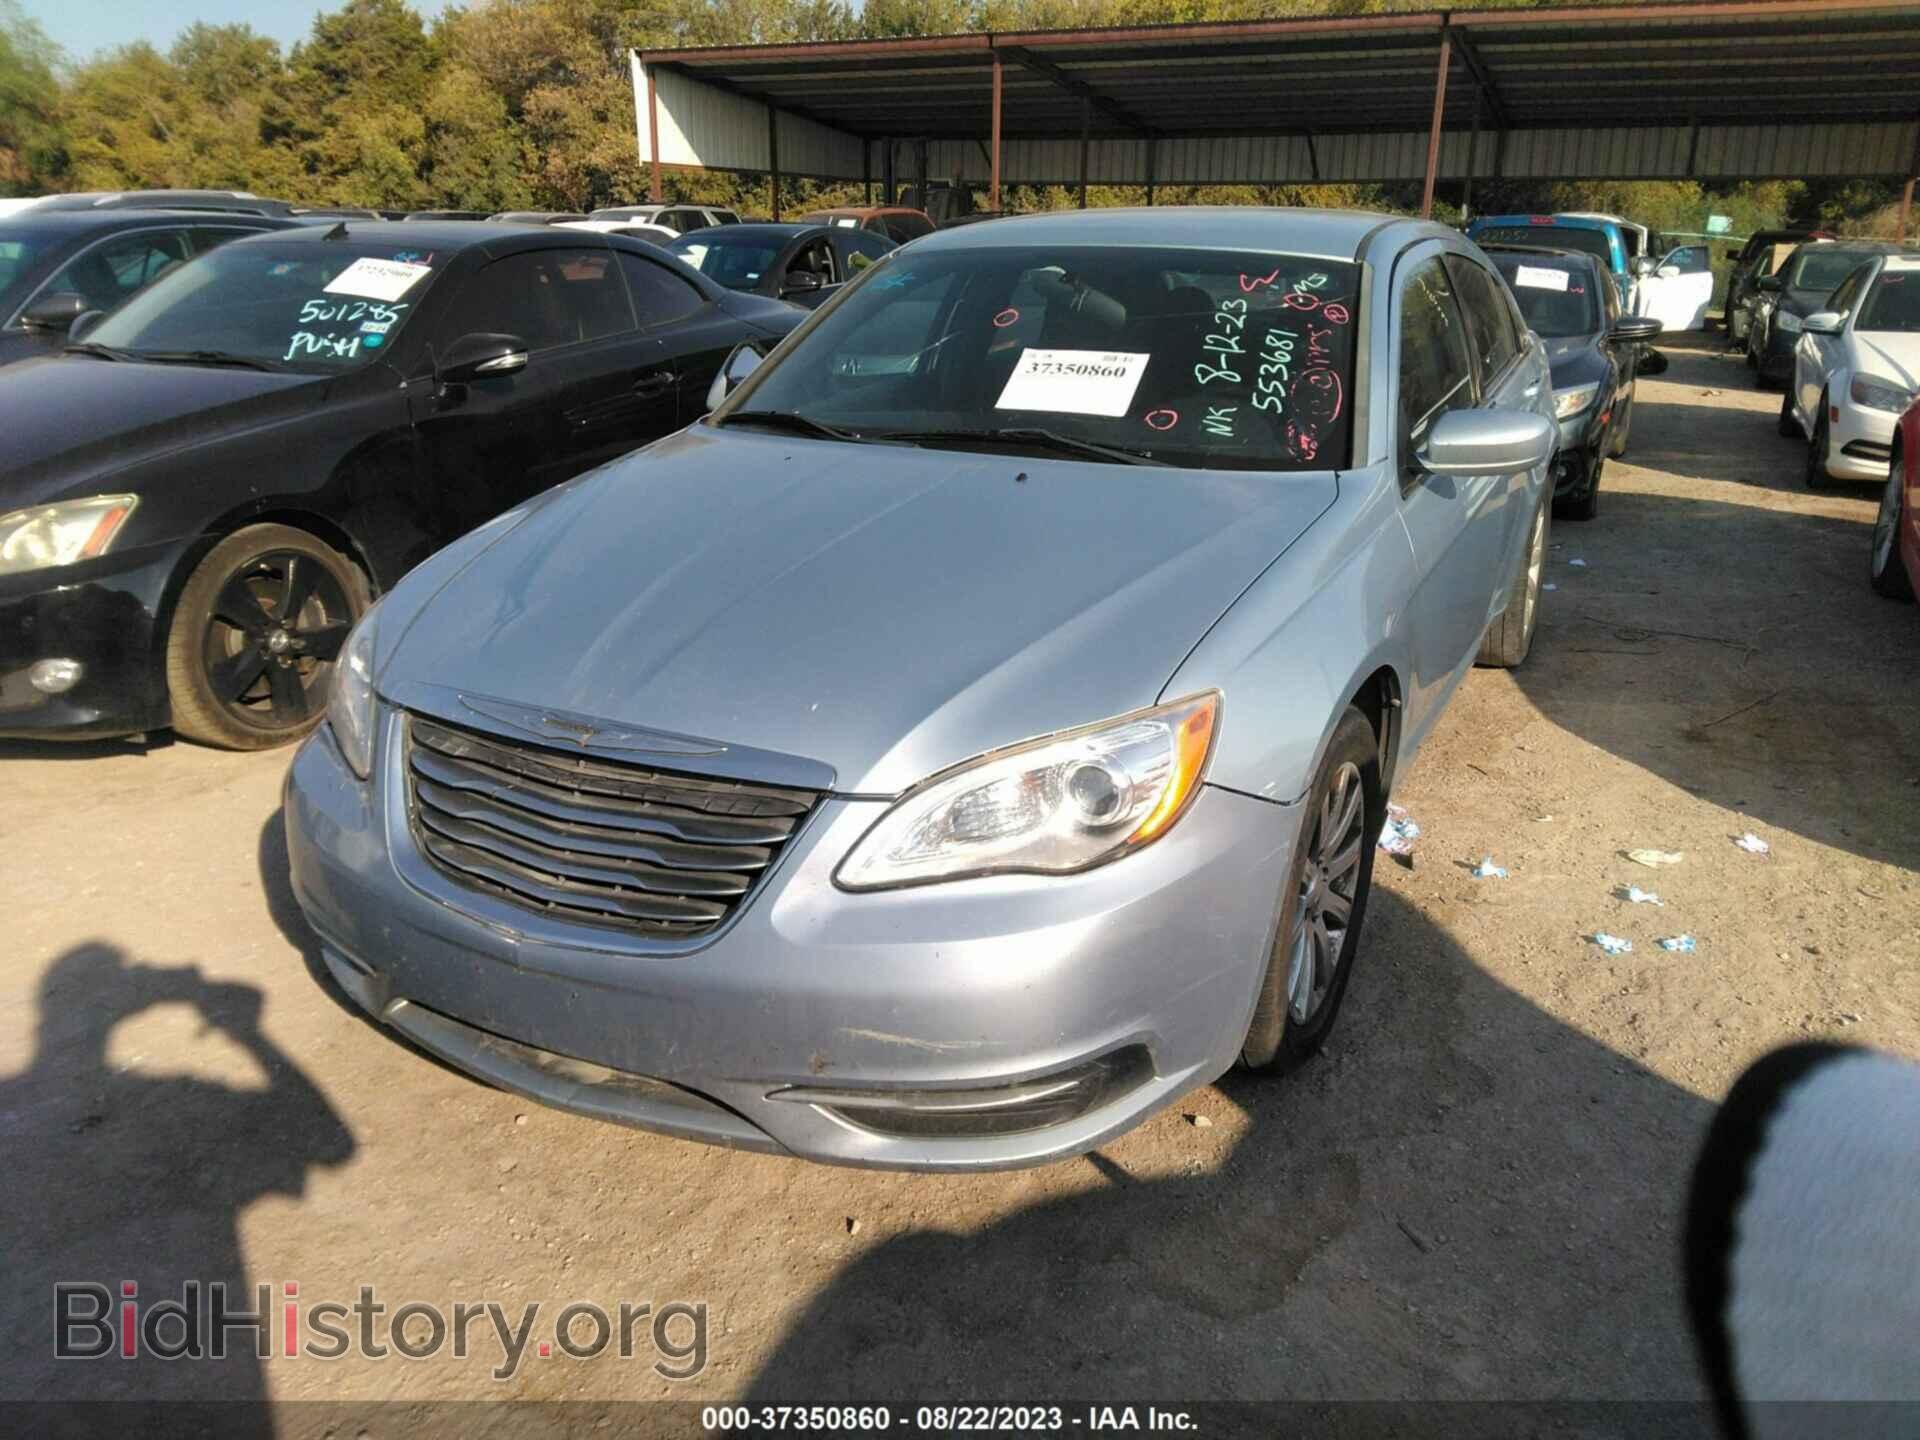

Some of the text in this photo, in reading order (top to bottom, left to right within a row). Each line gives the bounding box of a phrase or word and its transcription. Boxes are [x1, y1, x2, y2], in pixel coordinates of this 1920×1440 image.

[1025, 362, 1126, 378] 37350860
[1194, 299, 1247, 385] 8-12-23
[1251, 328, 1299, 413] 553681
